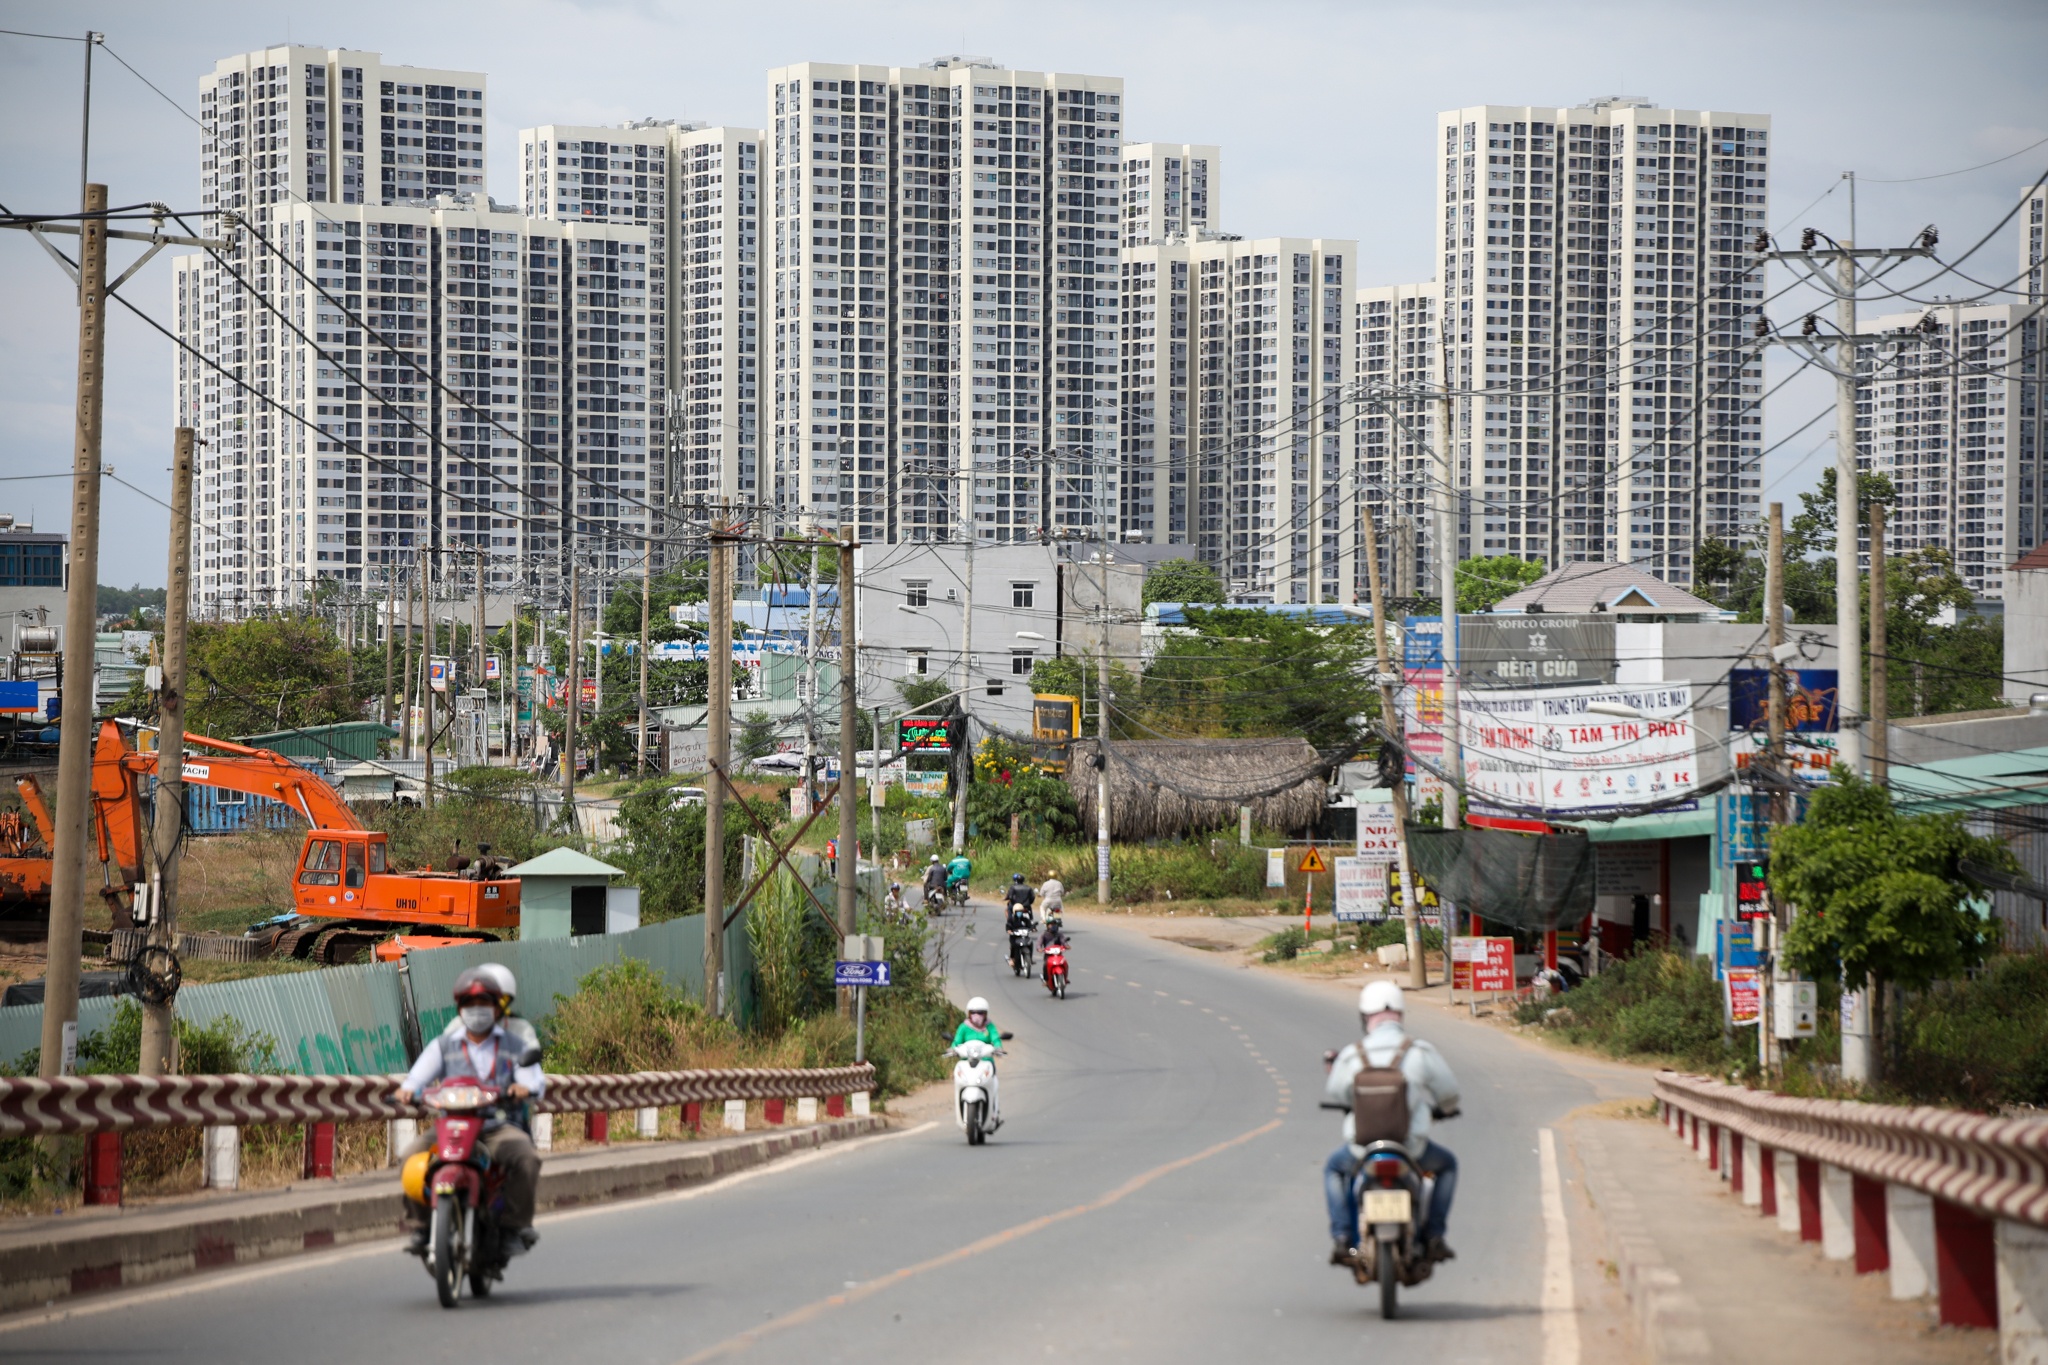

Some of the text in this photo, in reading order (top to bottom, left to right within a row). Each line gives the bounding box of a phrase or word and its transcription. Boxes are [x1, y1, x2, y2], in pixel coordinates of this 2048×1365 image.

[1497, 619, 1579, 629] SOFICO GROUP
[1658, 691, 1668, 708] XE
[1569, 723, 1602, 743] TÂM
[1364, 837, 1402, 849] ĐẤT
[396, 898, 417, 909] UH10
[1487, 941, 1505, 953] ẢO
[843, 965, 866, 976] Ford
[1476, 965, 1509, 978] MIỄN
